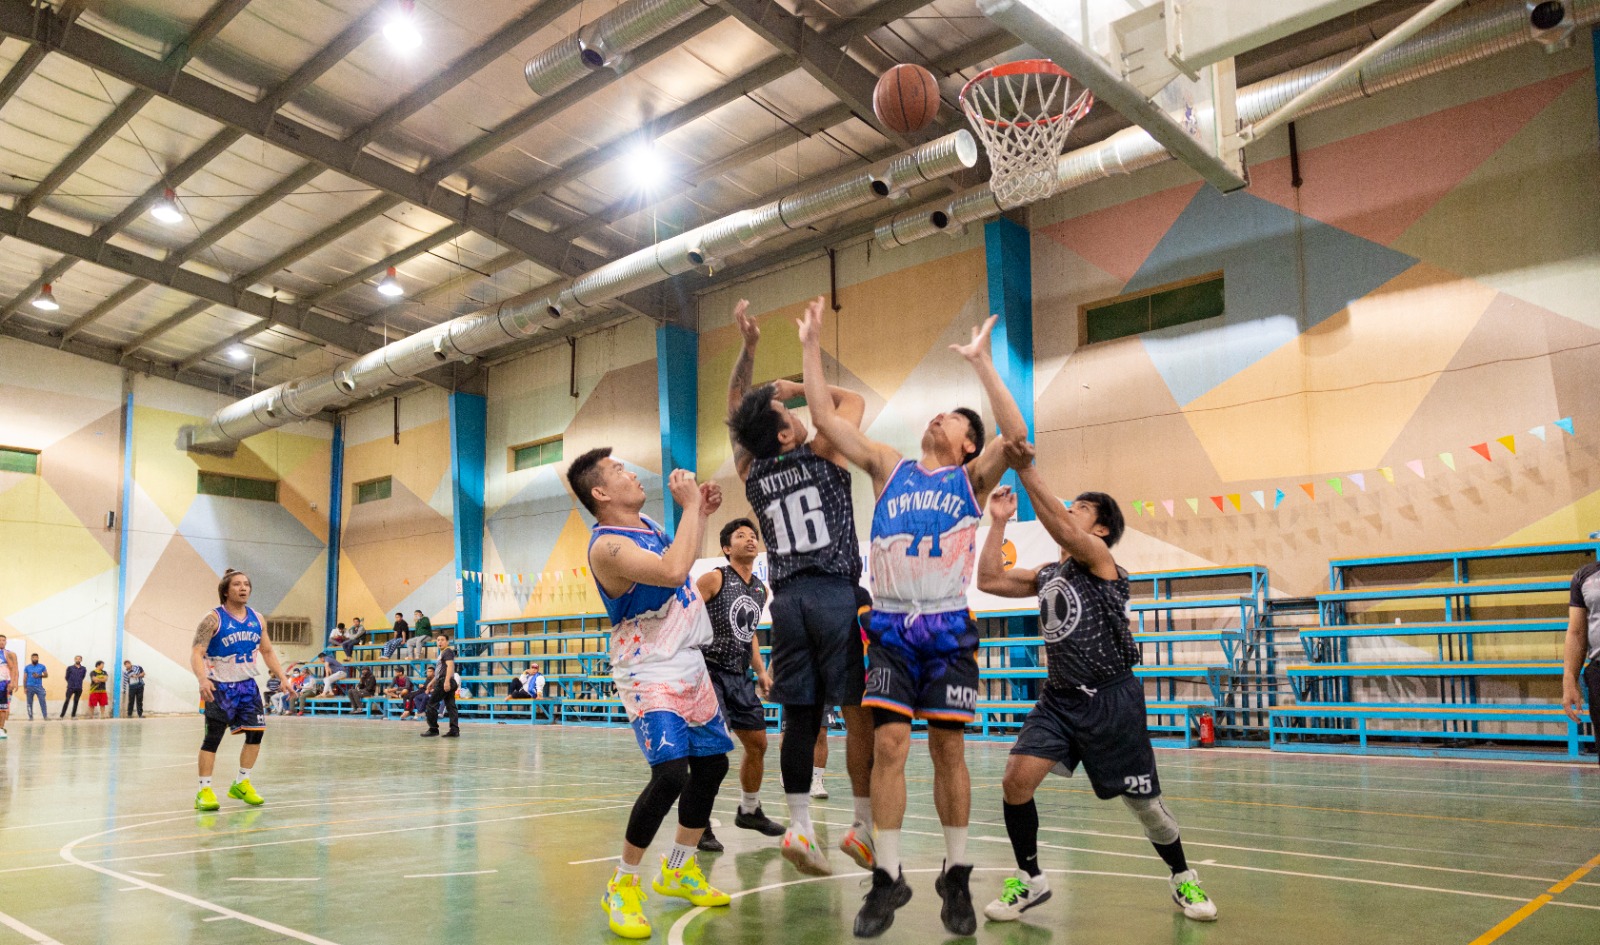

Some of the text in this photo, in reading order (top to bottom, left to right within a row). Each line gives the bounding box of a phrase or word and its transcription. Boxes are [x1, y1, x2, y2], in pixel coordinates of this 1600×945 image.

[758, 464, 812, 496] NITURA
[763, 485, 831, 555] 16
[1124, 773, 1152, 795] 25
